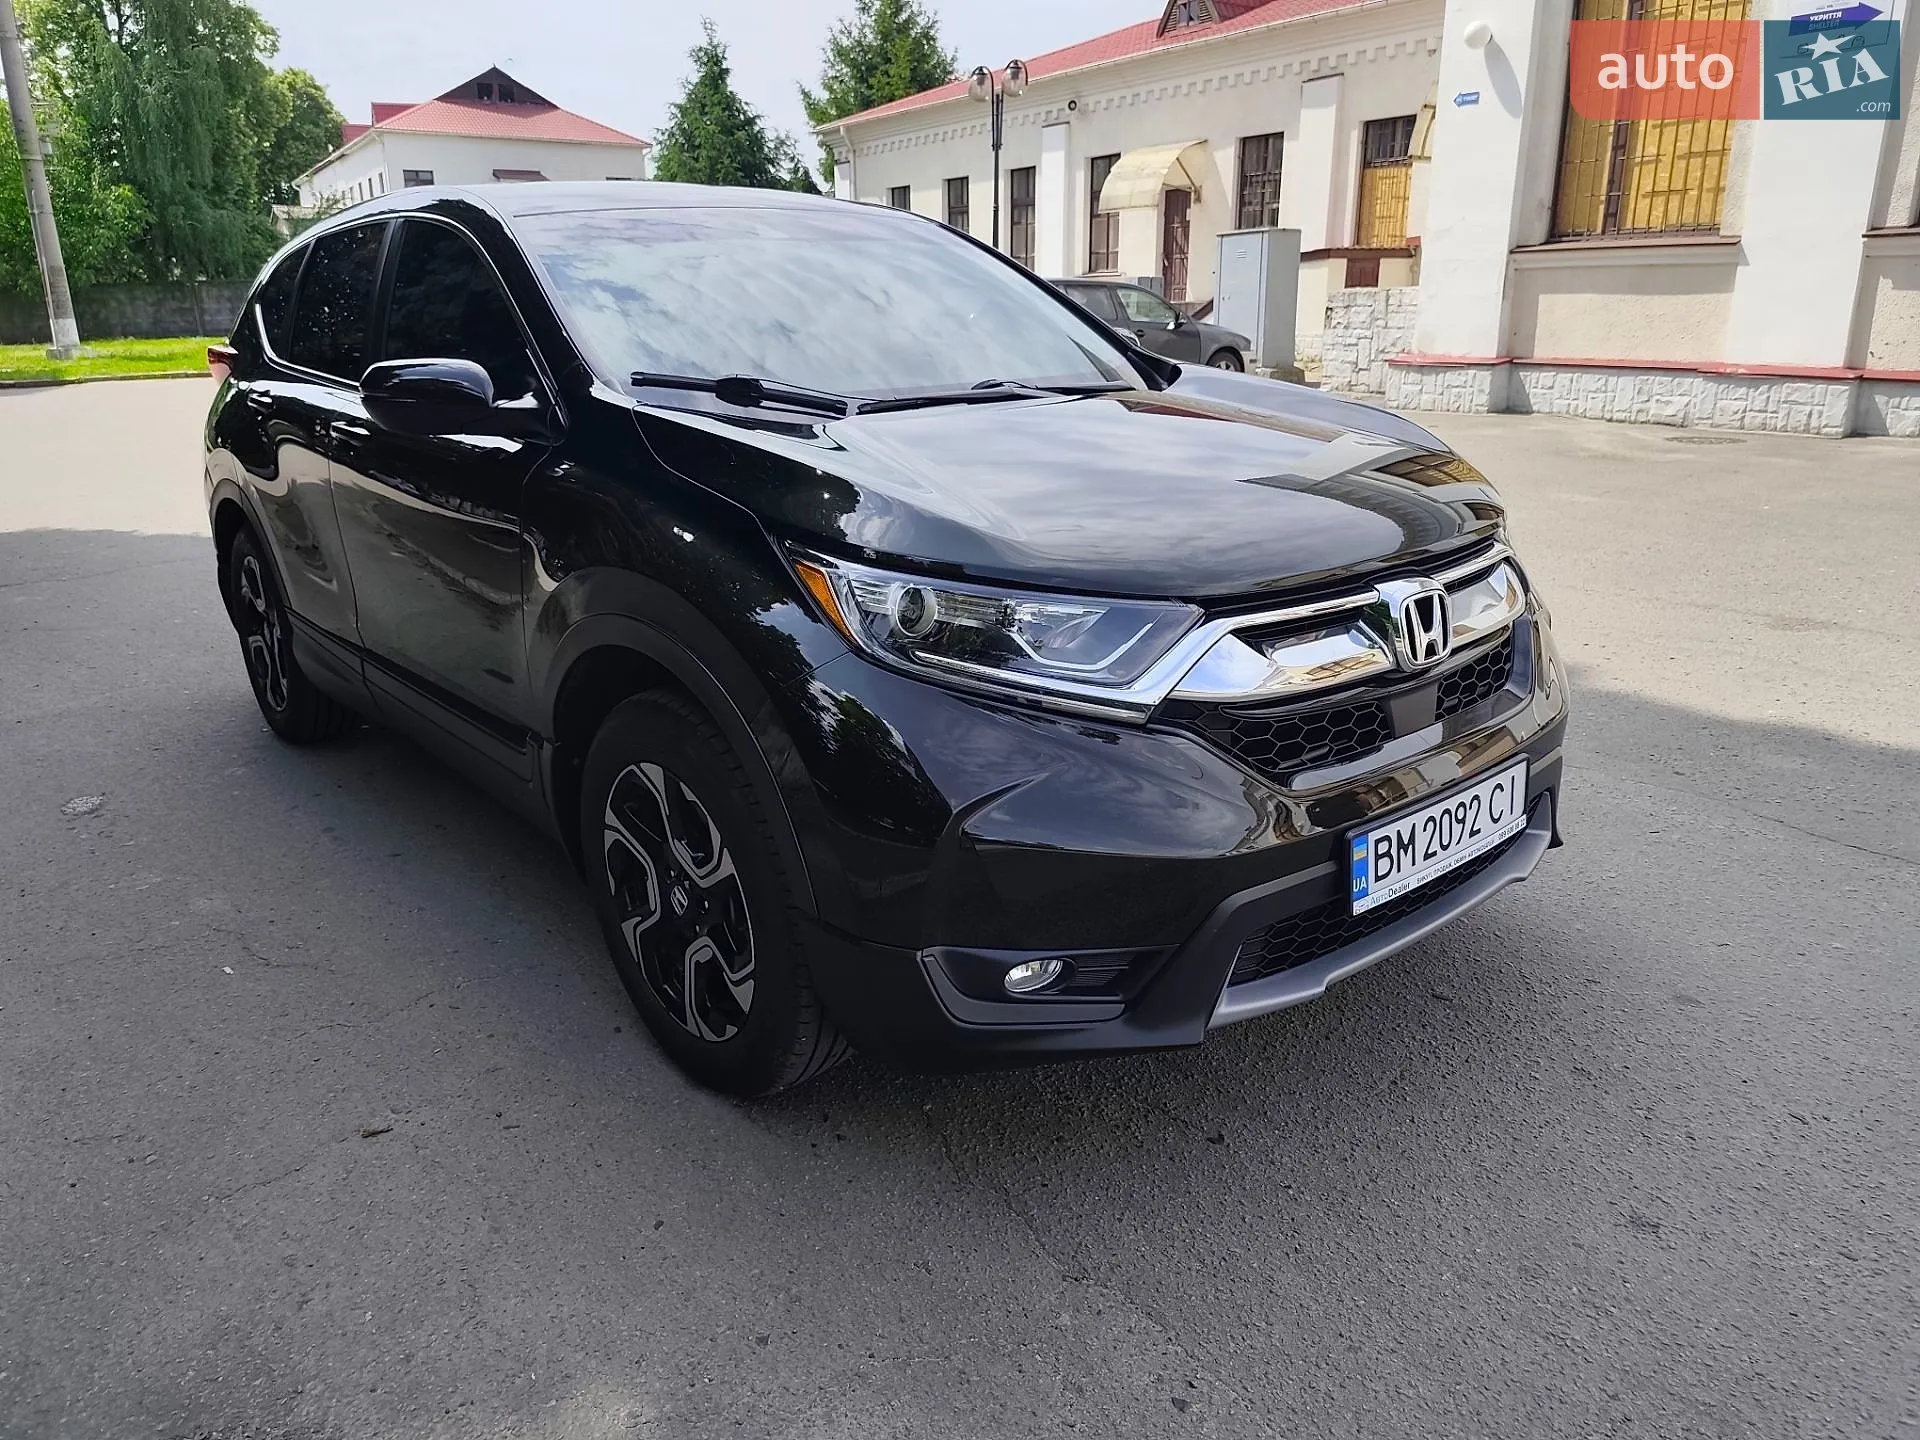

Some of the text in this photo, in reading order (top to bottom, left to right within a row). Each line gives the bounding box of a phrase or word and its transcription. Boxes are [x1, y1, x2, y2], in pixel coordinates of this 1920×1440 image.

[1809, 11, 1842, 21] УКРИТТЯ
[1808, 20, 1840, 30] SHELTER
[1374, 822, 1417, 883] BM
[1423, 794, 1481, 862] 2092
[1353, 876, 1367, 892] UA
